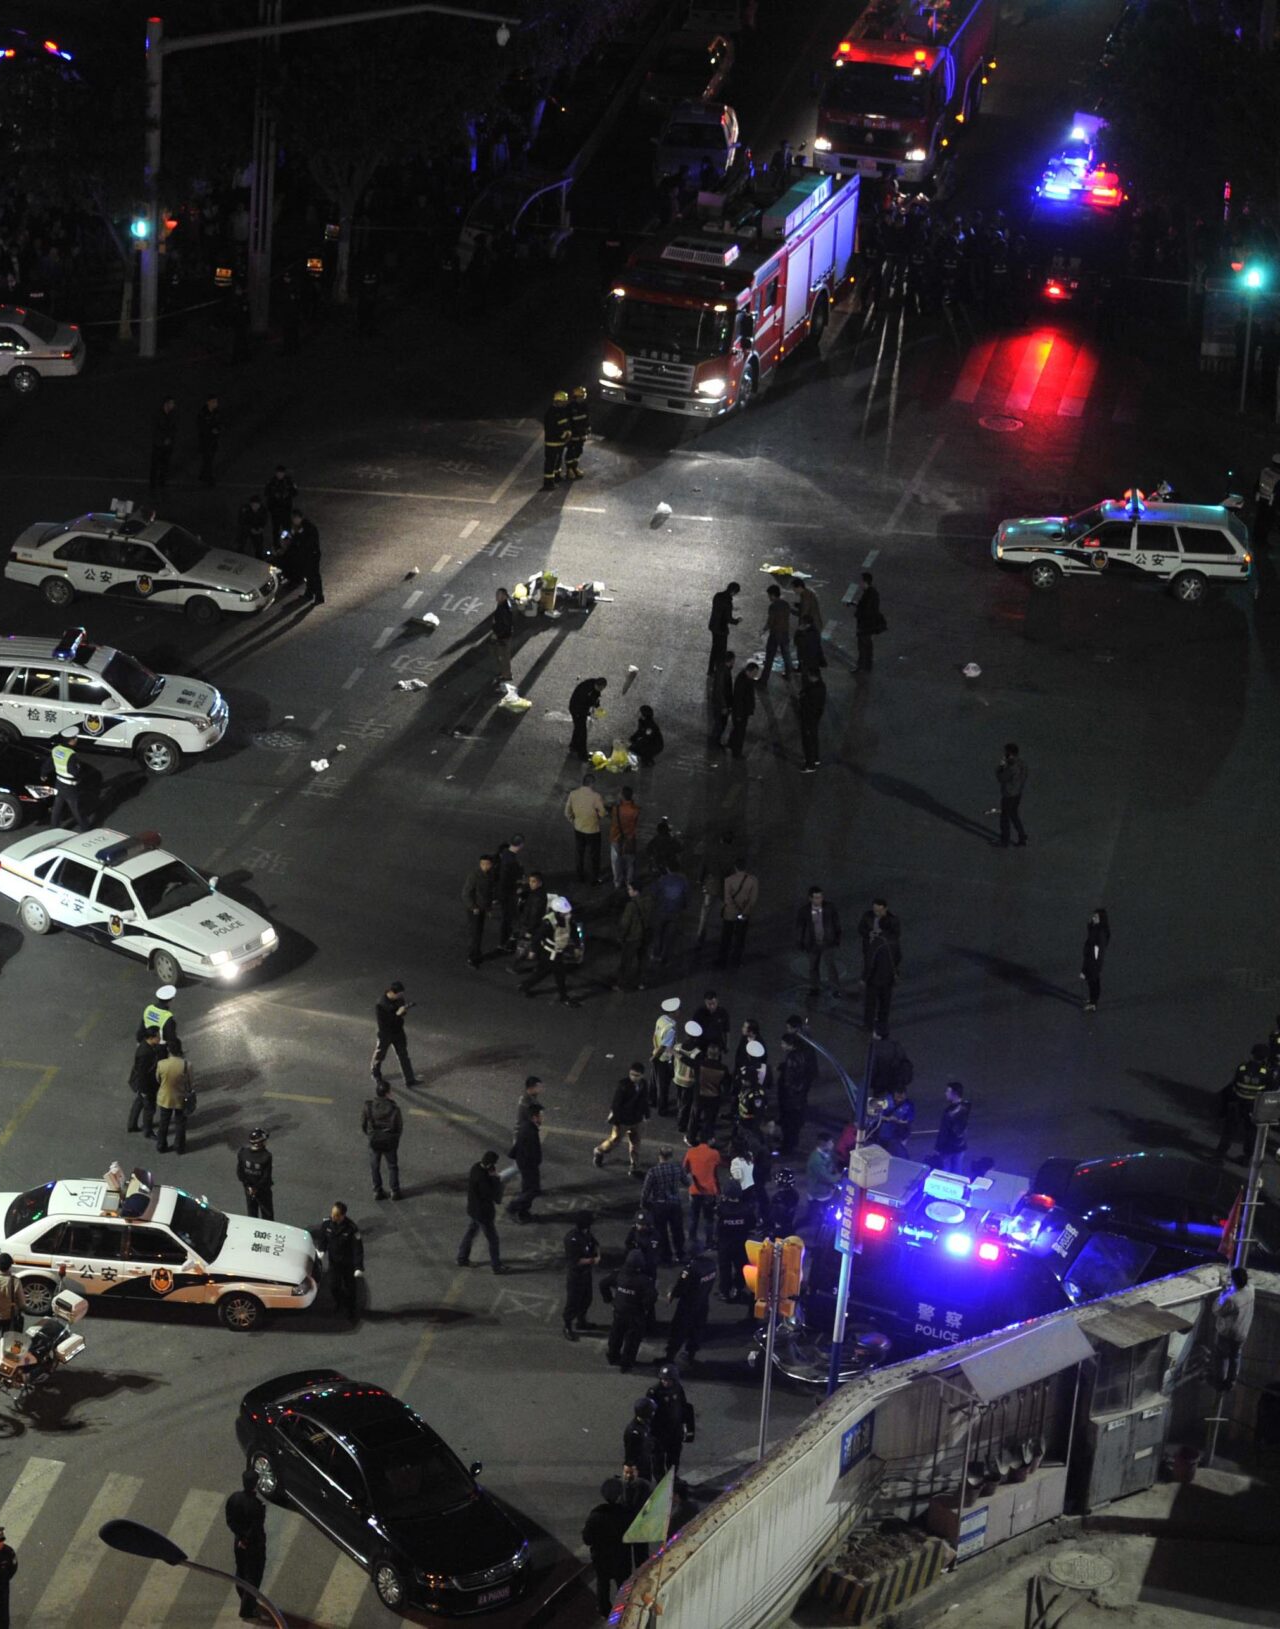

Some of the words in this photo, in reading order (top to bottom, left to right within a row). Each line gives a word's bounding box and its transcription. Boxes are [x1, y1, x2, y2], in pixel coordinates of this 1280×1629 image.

[1135, 553, 1165, 566] 公安
[84, 567, 113, 584] 公安
[27, 707, 58, 724] 检察
[200, 911, 236, 931] 警察
[212, 919, 245, 937] POLICE
[77, 1185, 99, 1208] 2911
[251, 1230, 271, 1254] 警察
[272, 1233, 286, 1257] POLICE
[78, 1263, 119, 1283] 公安
[917, 1302, 964, 1330] 警察
[914, 1323, 960, 1344] POLICE
